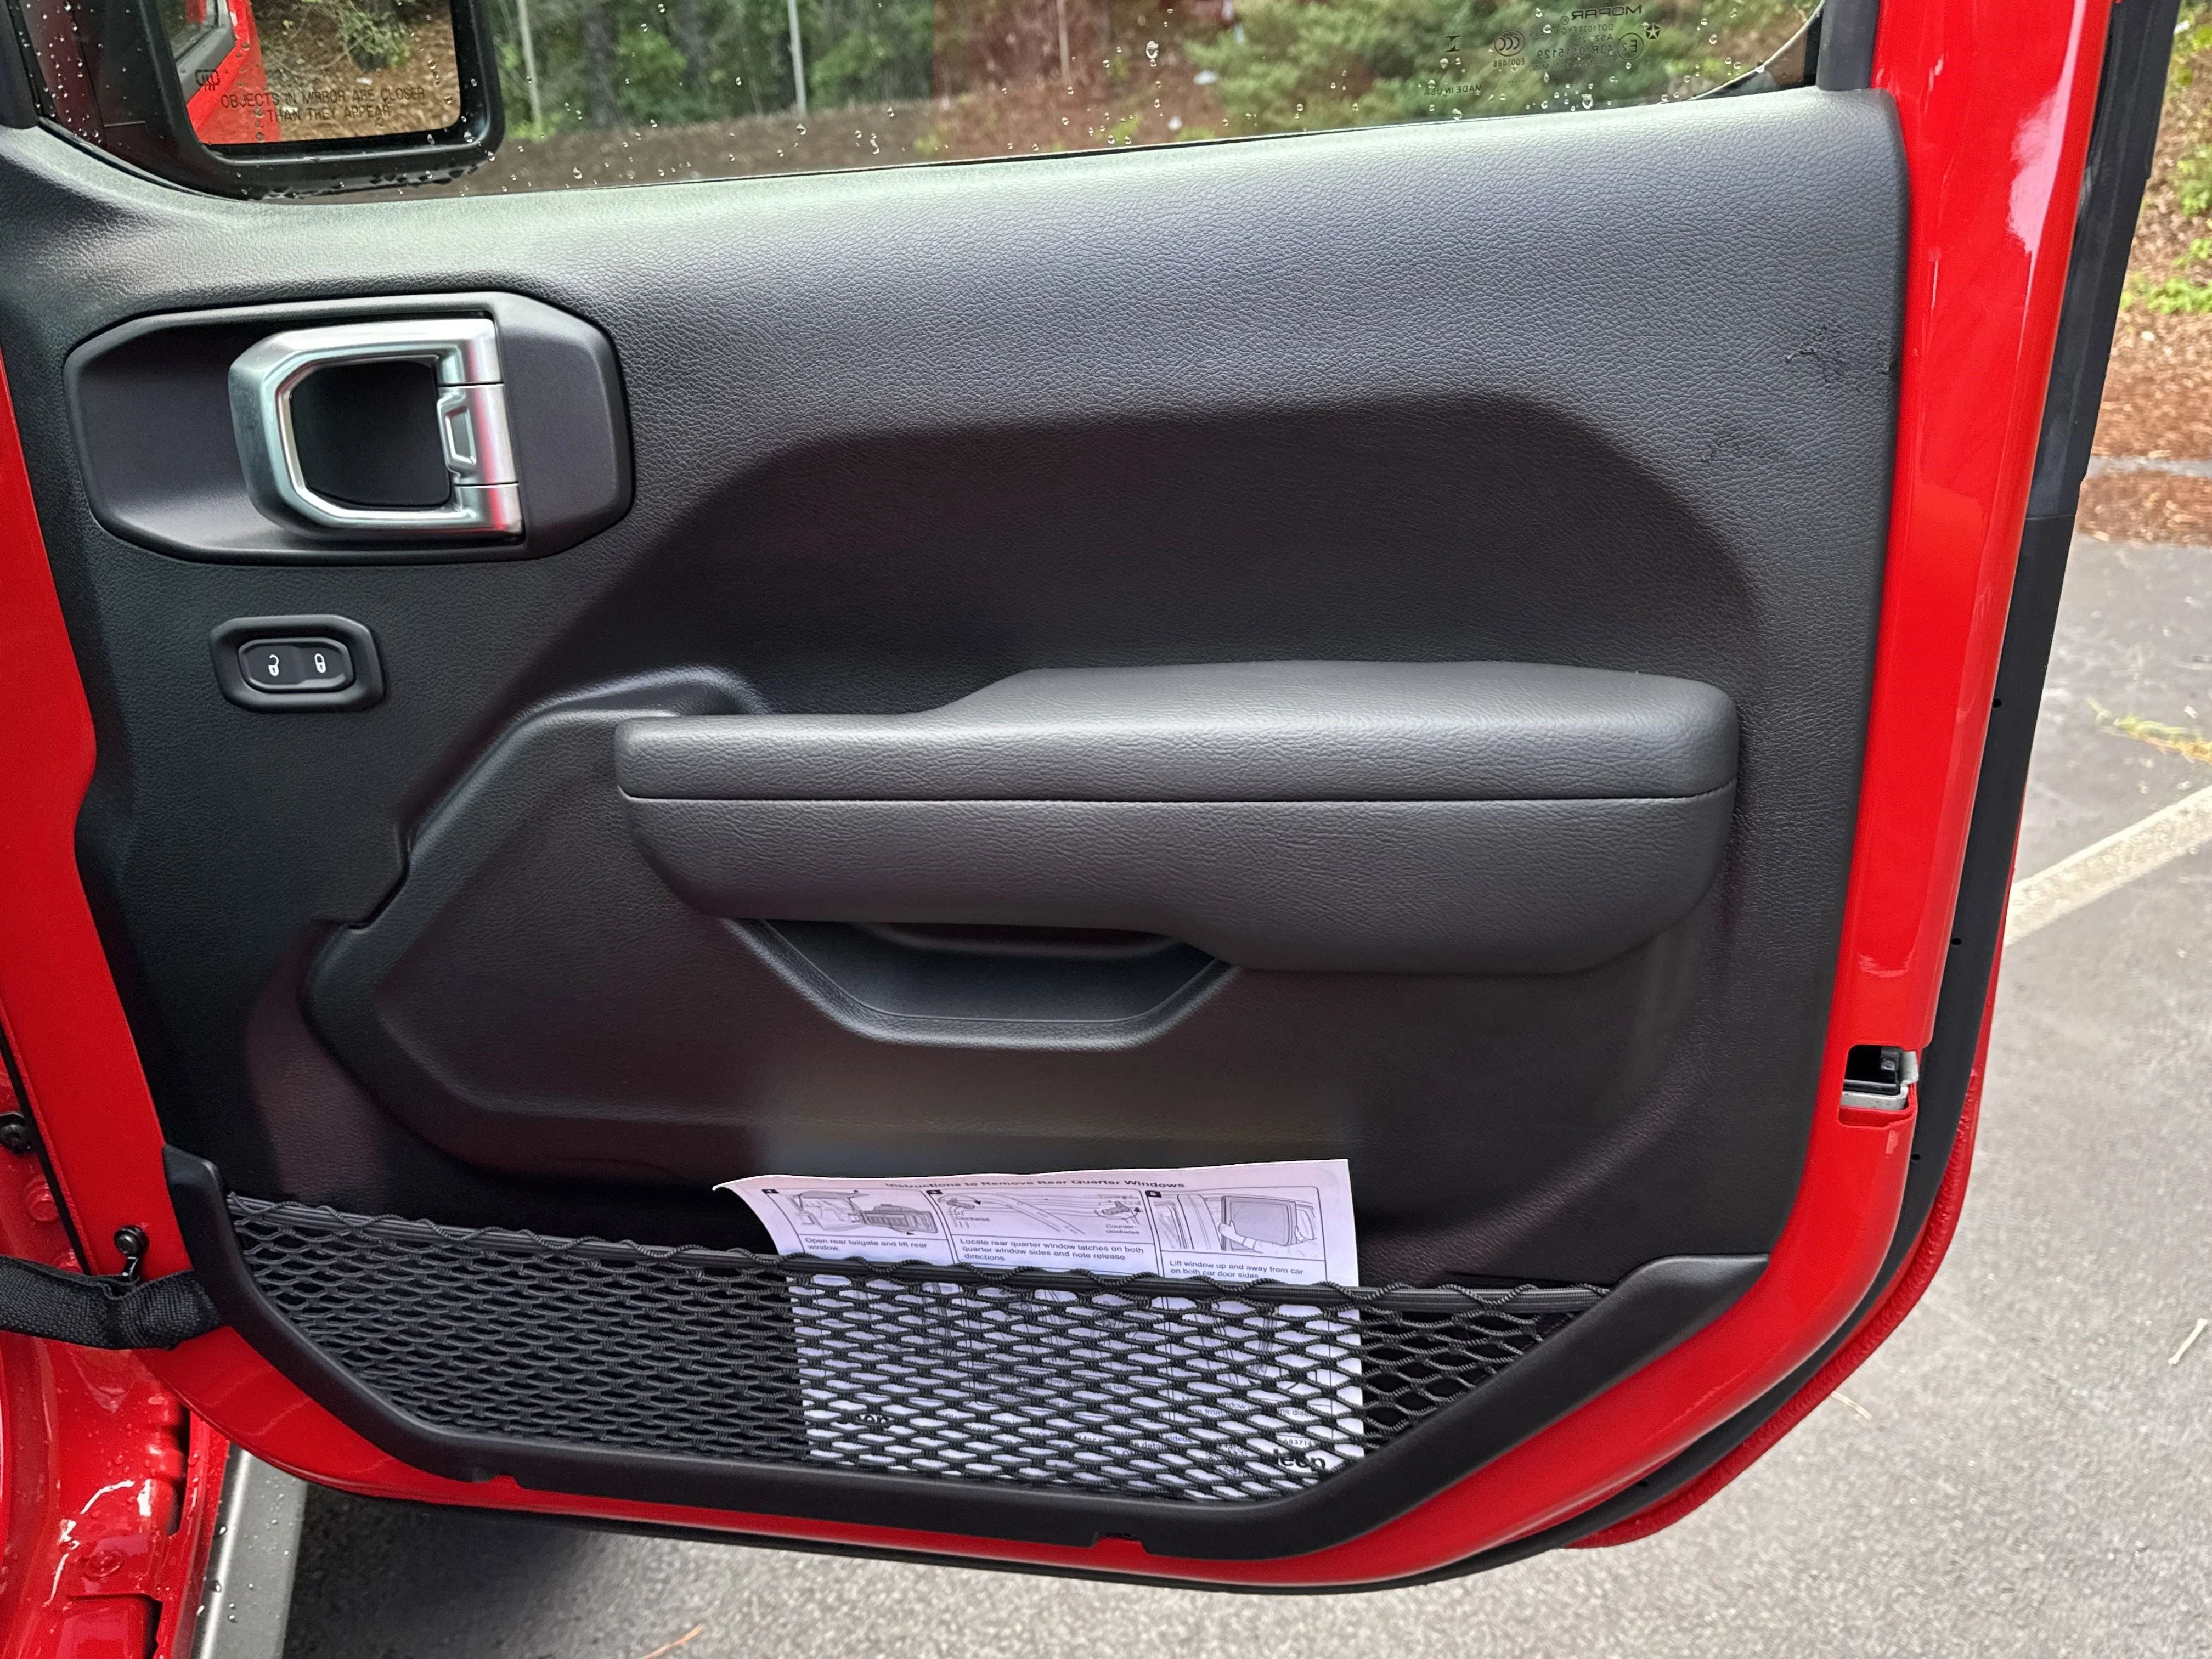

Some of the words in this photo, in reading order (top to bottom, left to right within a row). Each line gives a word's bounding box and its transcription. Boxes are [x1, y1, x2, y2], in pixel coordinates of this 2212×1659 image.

[221, 92, 280, 108] OBJECTS
[283, 92, 298, 105] IN
[302, 89, 346, 104] MIRROR
[352, 88, 375, 103] ARE
[380, 86, 425, 101] CLOSER
[268, 108, 302, 123] THAN
[308, 106, 336, 121] THEY
[343, 104, 391, 119] APPEAR
[1124, 1180, 1186, 1188] Windows
[849, 1239, 879, 1247] tailgate
[1043, 1242, 1075, 1250] window
[964, 1253, 1006, 1261] directions.
[1246, 1265, 1267, 1273] away
